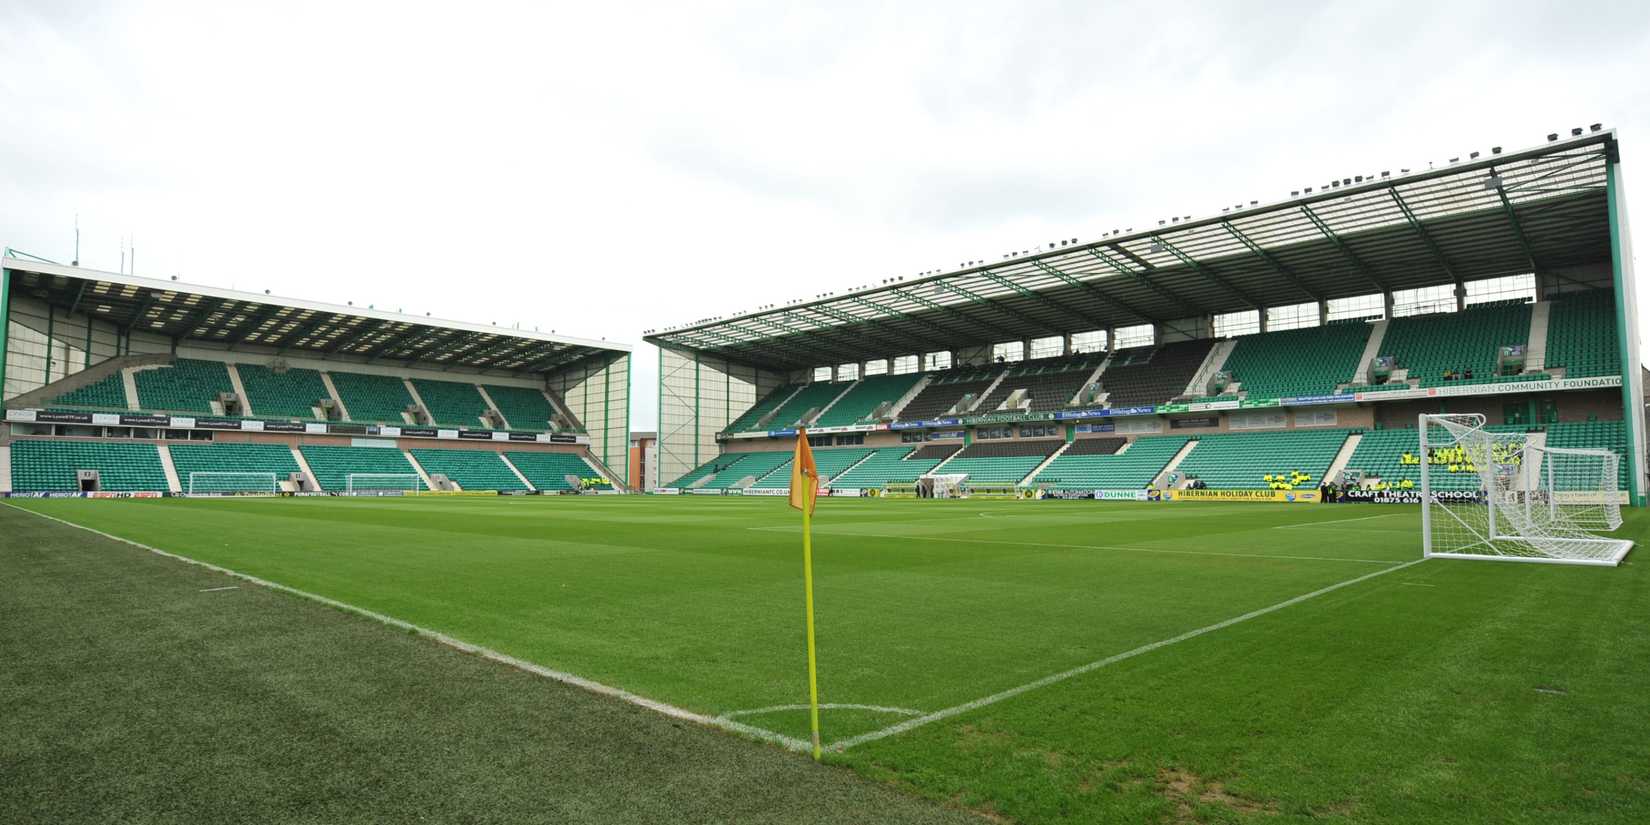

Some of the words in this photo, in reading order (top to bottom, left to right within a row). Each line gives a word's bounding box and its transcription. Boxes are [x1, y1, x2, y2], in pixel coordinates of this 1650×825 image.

[1439, 385, 1496, 395] HIBERNIAN
[1498, 381, 1560, 392] COMMUNITY
[1563, 377, 1622, 388] FOUNDATIO
[1255, 490, 1276, 498] CLUB
[1348, 490, 1380, 498] CRAFT
[1383, 490, 1423, 498] THEATR
[1431, 490, 1479, 498] SCHOOL
